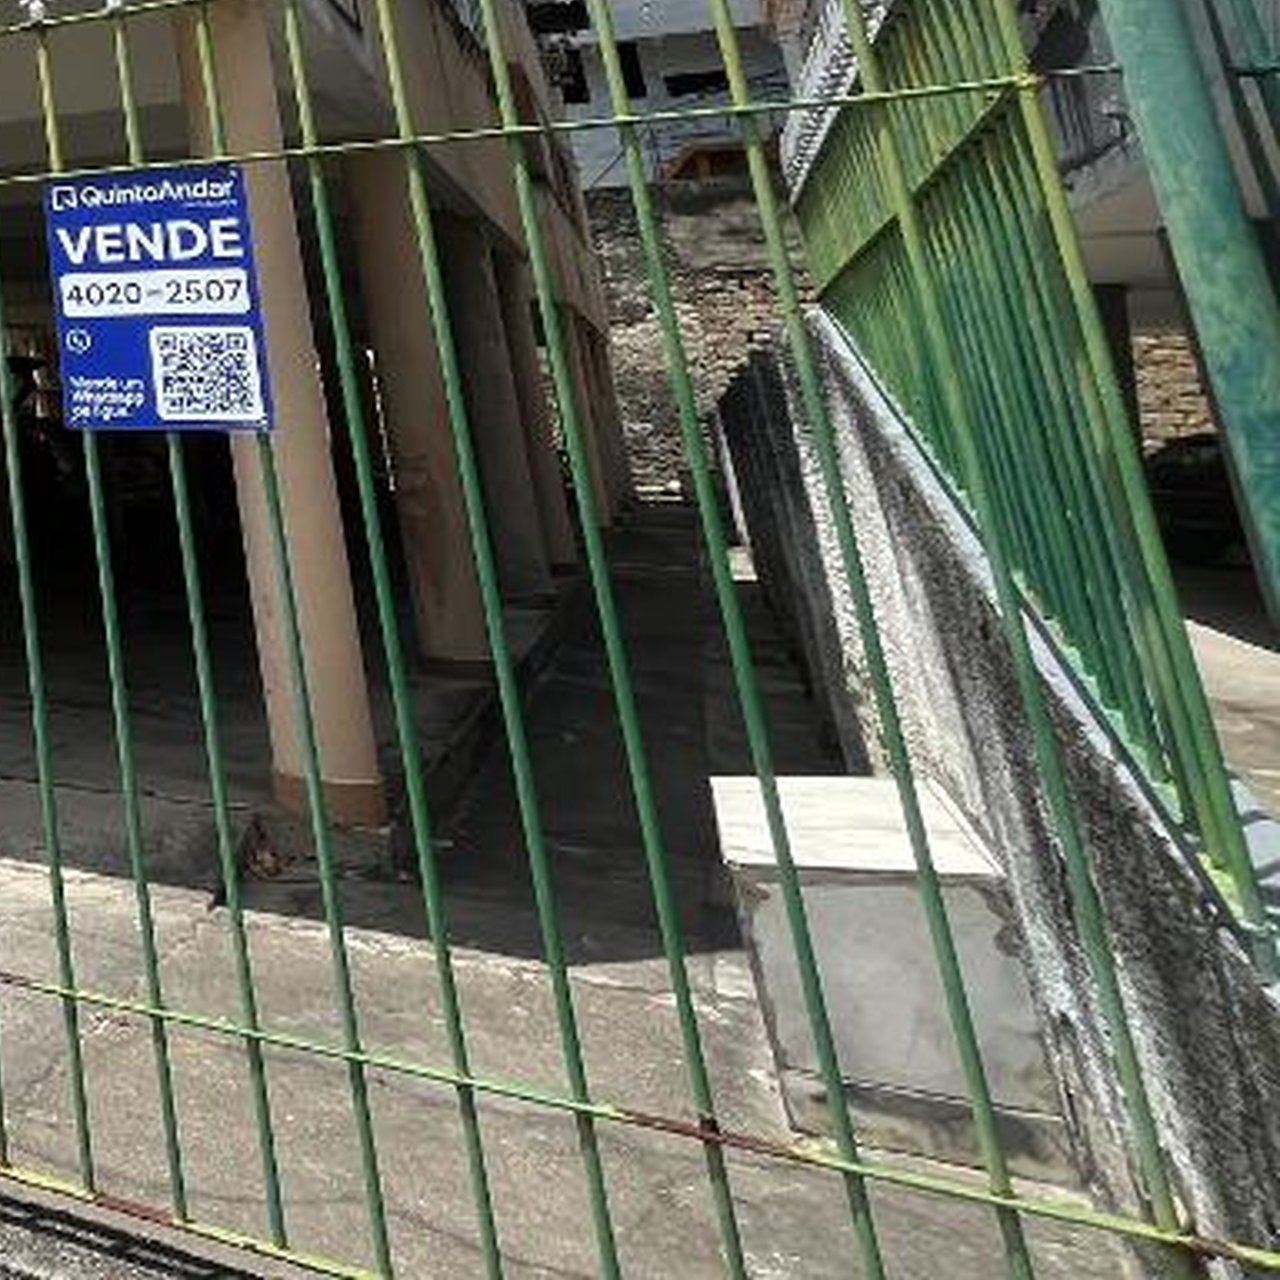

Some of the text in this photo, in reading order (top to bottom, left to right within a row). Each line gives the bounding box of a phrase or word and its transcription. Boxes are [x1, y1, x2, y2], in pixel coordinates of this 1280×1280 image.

[80, 178, 234, 208] QuintoAndar
[56, 218, 244, 265] VENDE
[66, 278, 243, 306] 4020-2507
